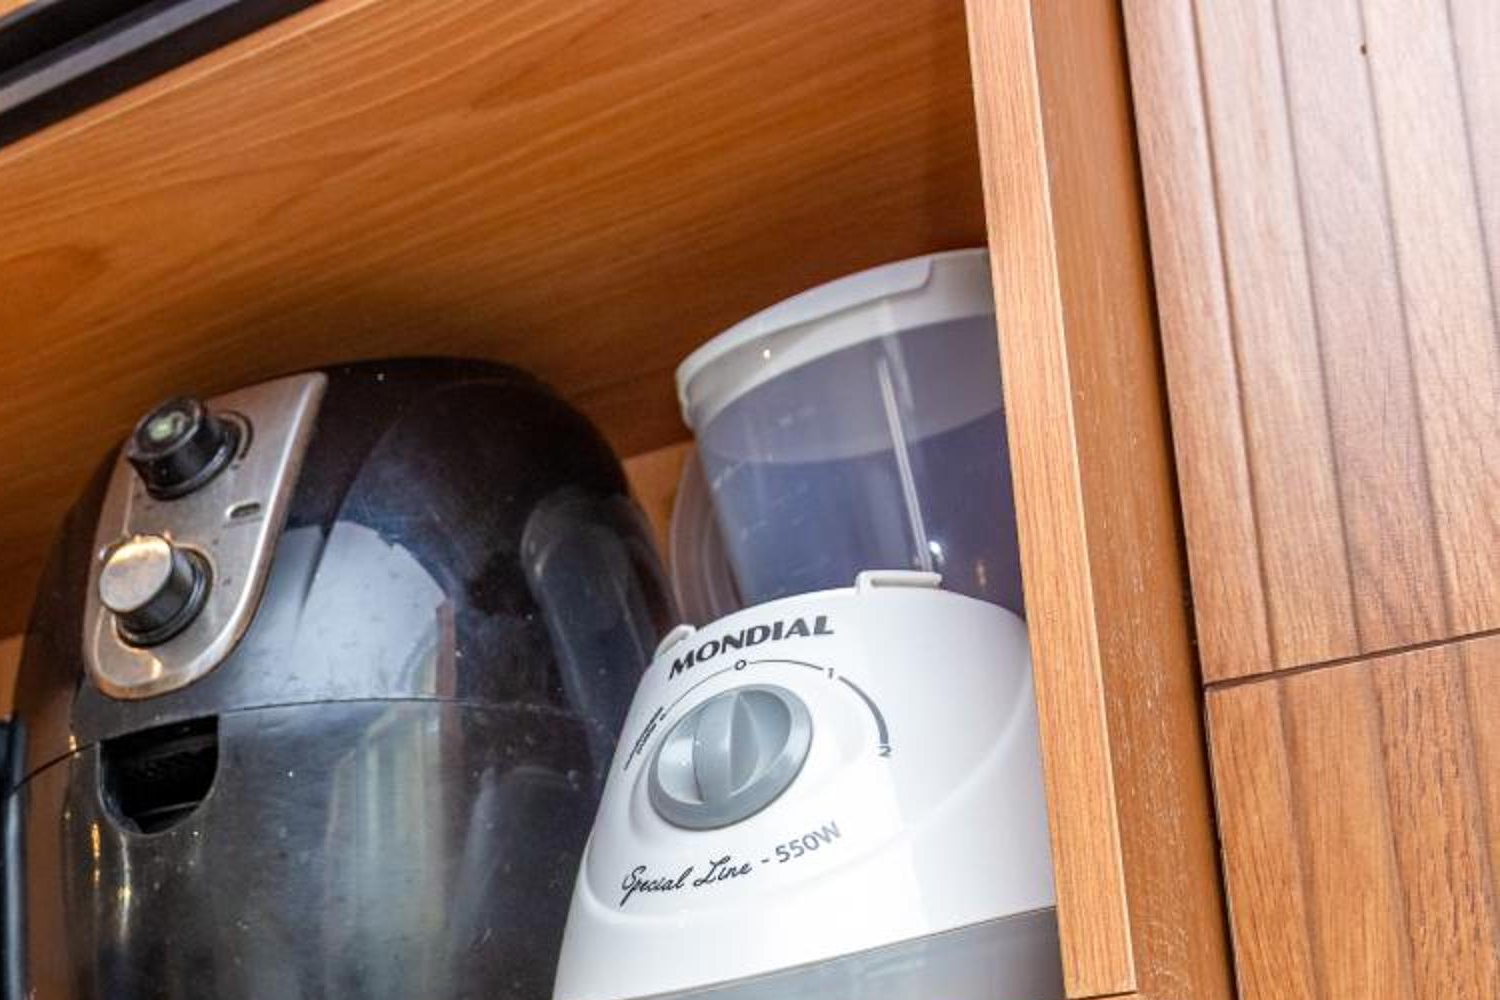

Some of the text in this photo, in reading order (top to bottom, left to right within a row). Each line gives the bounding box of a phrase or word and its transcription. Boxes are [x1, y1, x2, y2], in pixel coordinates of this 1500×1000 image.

[668, 615, 834, 680] MONDIAL
[620, 865, 692, 908] Special
[693, 855, 752, 887] Line
[774, 820, 842, 864] 550W
